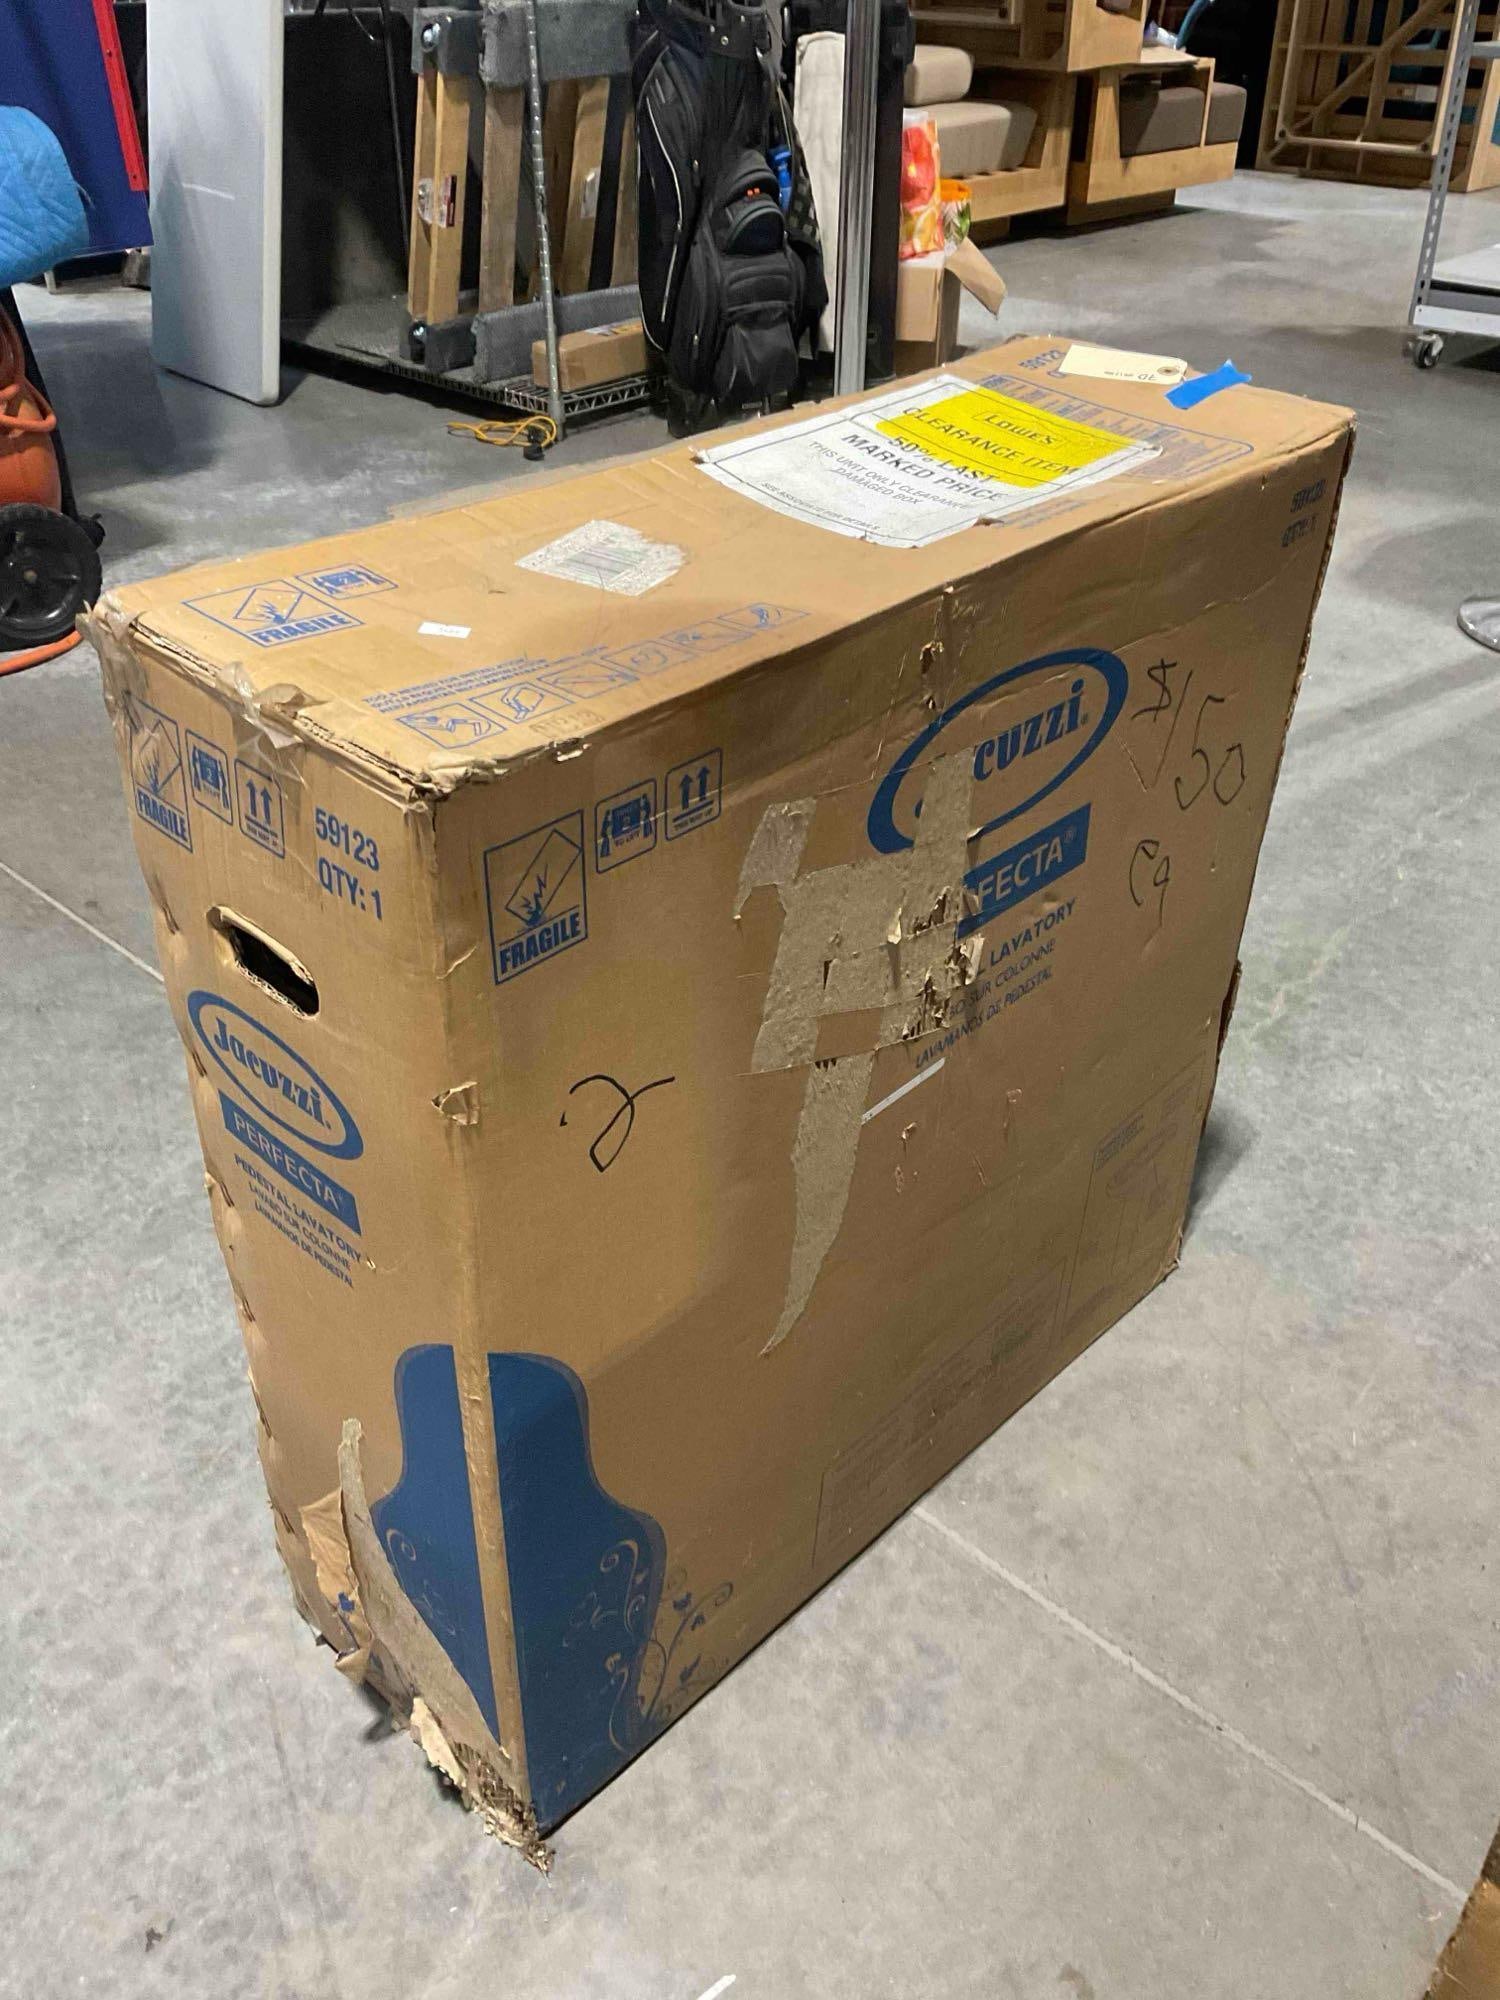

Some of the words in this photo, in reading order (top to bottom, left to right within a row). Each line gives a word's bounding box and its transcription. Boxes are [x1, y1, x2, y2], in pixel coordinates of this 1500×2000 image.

[841, 433, 936, 480] MARKED
[934, 477, 1009, 502] PRICE
[888, 436, 937, 463] 50%
[937, 458, 1003, 484] LAST
[903, 407, 1025, 461] CLEARANCE
[1020, 455, 1082, 475] ITEM
[809, 441, 838, 460] THIS
[836, 455, 869, 474] UNIT
[866, 469, 899, 488] ONLY
[898, 483, 970, 511] CLEARANCE
[834, 466, 896, 497] DAMAGED
[891, 491, 925, 506] BOX
[252, 613, 350, 644] FRAGILE
[136, 787, 189, 842] FRAGILE
[314, 806, 380, 872] 59123
[977, 836, 1063, 913] FECTA
[499, 911, 582, 975] FRAGILE
[989, 898, 1077, 967] LAVATORY
[213, 1016, 329, 1130] Jacuzzi
[233, 1111, 341, 1211] PERFECTA
[234, 1152, 293, 1210] PEDESTAL
[292, 1202, 361, 1264] LAVATORY
